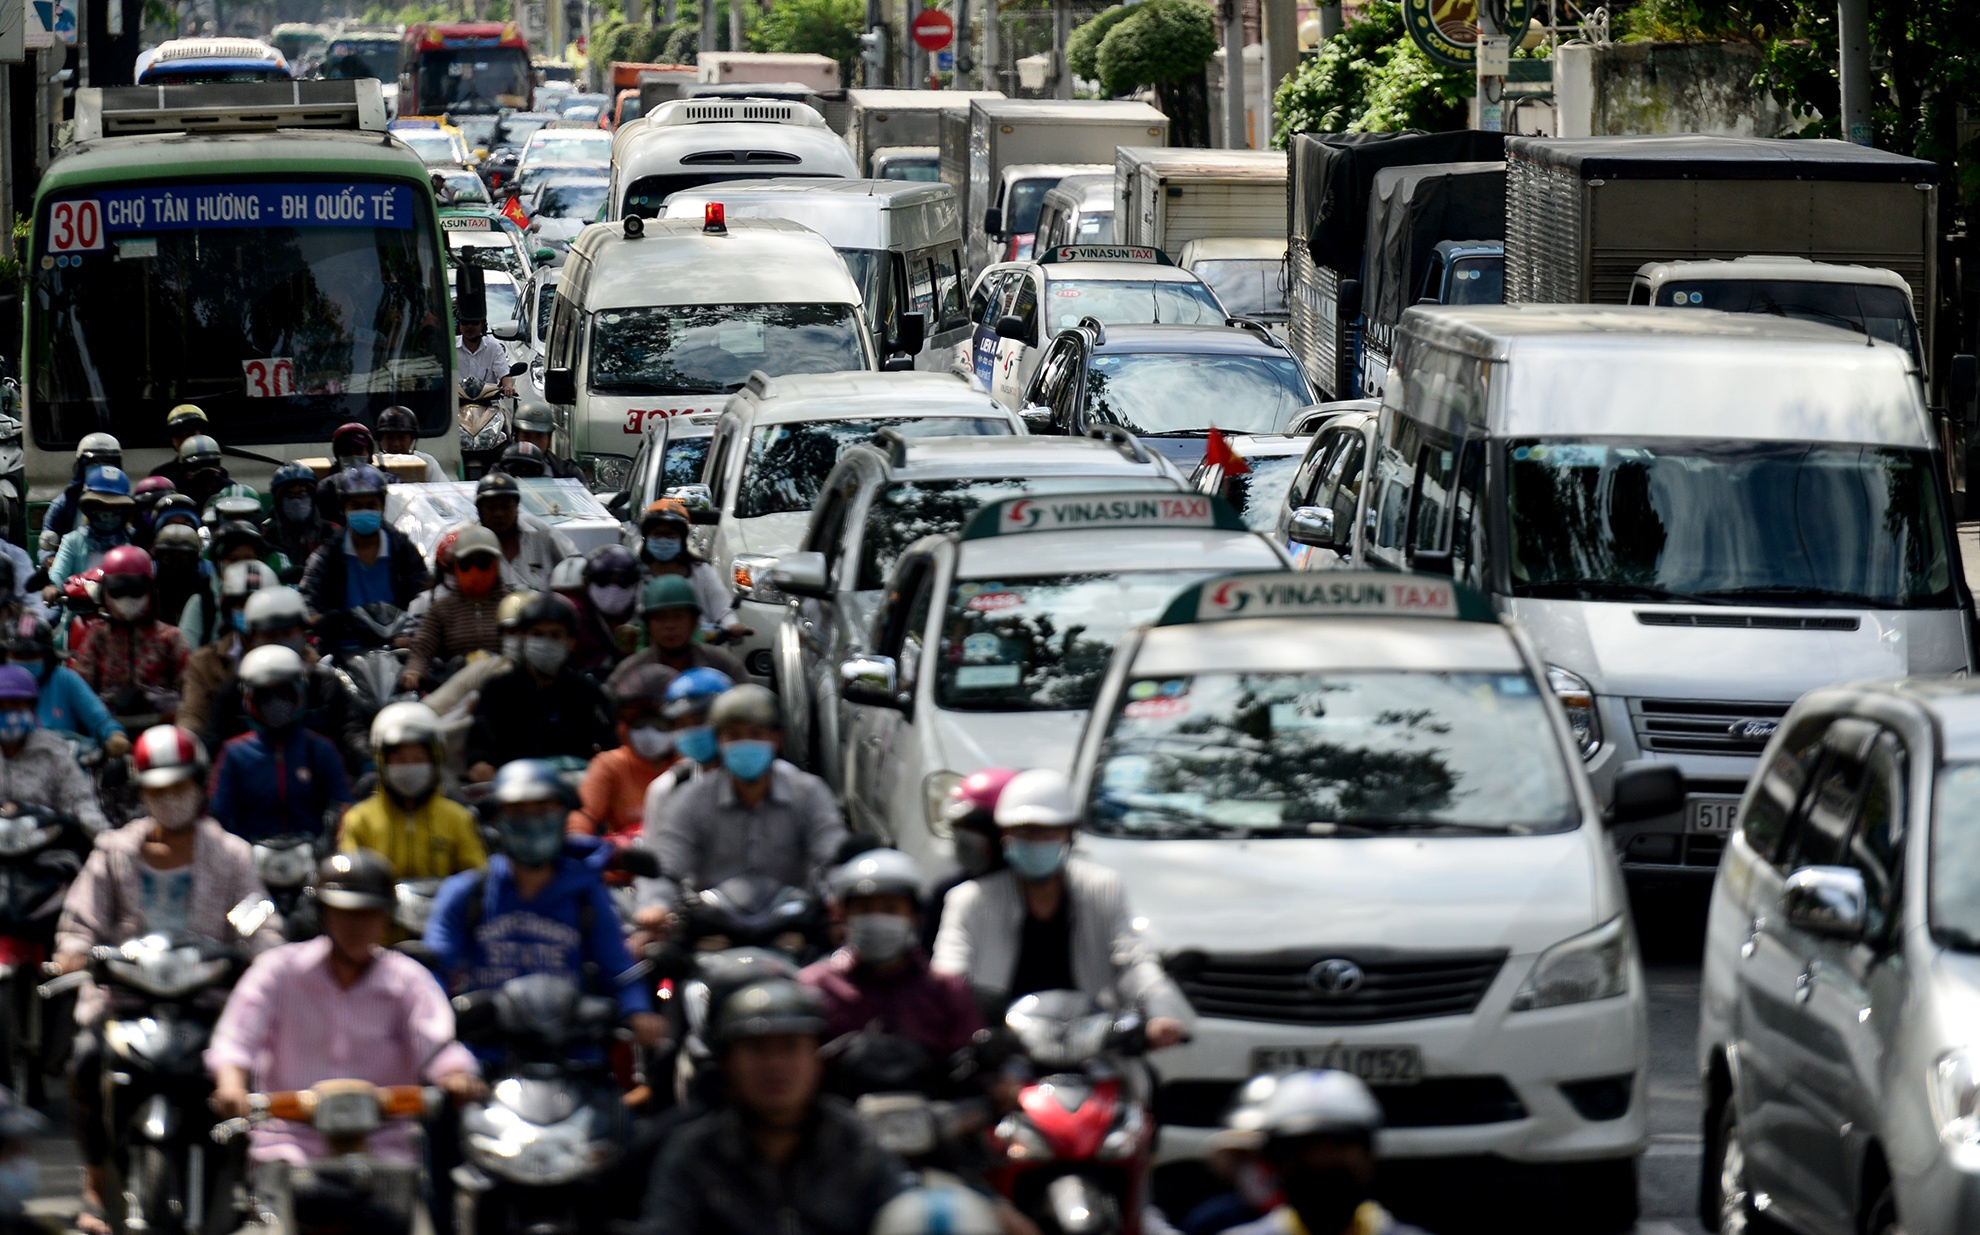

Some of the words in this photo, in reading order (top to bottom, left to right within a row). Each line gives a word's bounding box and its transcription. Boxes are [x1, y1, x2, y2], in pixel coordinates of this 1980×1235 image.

[54, 202, 98, 250] 30
[107, 196, 146, 228] CHỢ
[152, 192, 189, 222] TÂN
[196, 192, 260, 221] HƯƠNG
[281, 195, 308, 220] ĐH
[315, 186, 365, 221] QUỐC
[371, 187, 397, 221] TẾ
[246, 359, 296, 398] 30
[1259, 581, 1387, 606] VINASUN
[1391, 584, 1450, 610] TAXI
